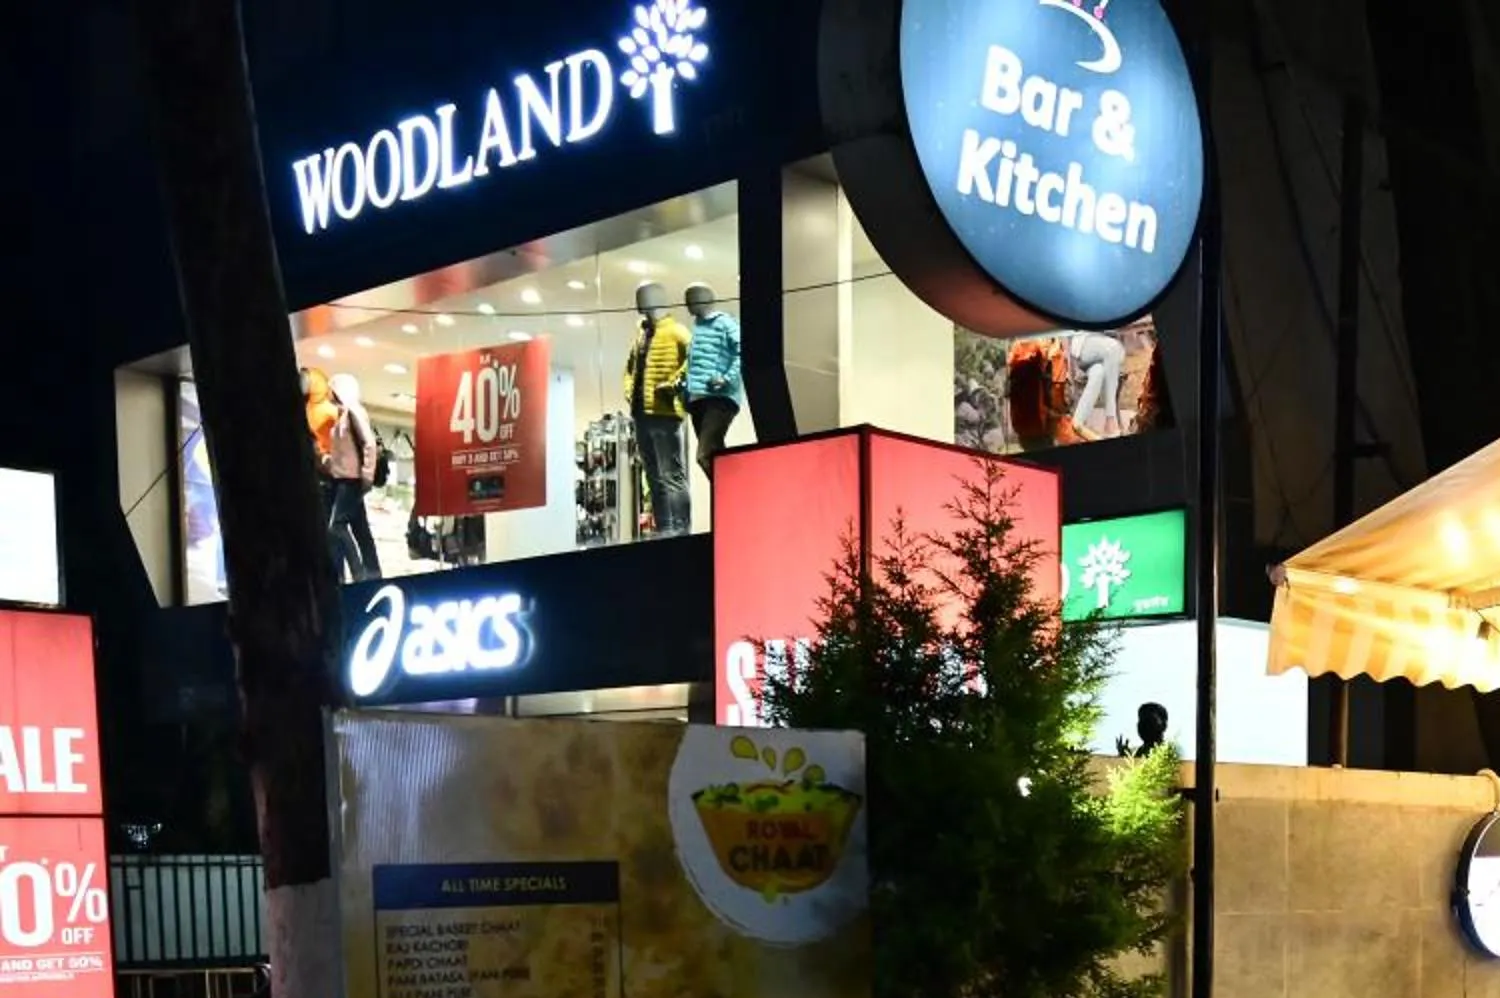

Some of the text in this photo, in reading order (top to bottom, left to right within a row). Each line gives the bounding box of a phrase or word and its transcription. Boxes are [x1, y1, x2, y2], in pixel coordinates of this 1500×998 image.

[293, 49, 613, 234] WOODLAND
[980, 44, 1135, 161] Bar &
[957, 129, 1157, 252] Kitchen
[451, 364, 521, 444] 40%
[402, 593, 527, 675] asics
[441, 876, 568, 893] ALL TIME SPECIALS
[728, 844, 830, 873] CHAAT
[1, 955, 104, 972] AND GET 50%
[61, 927, 94, 945] OFF
